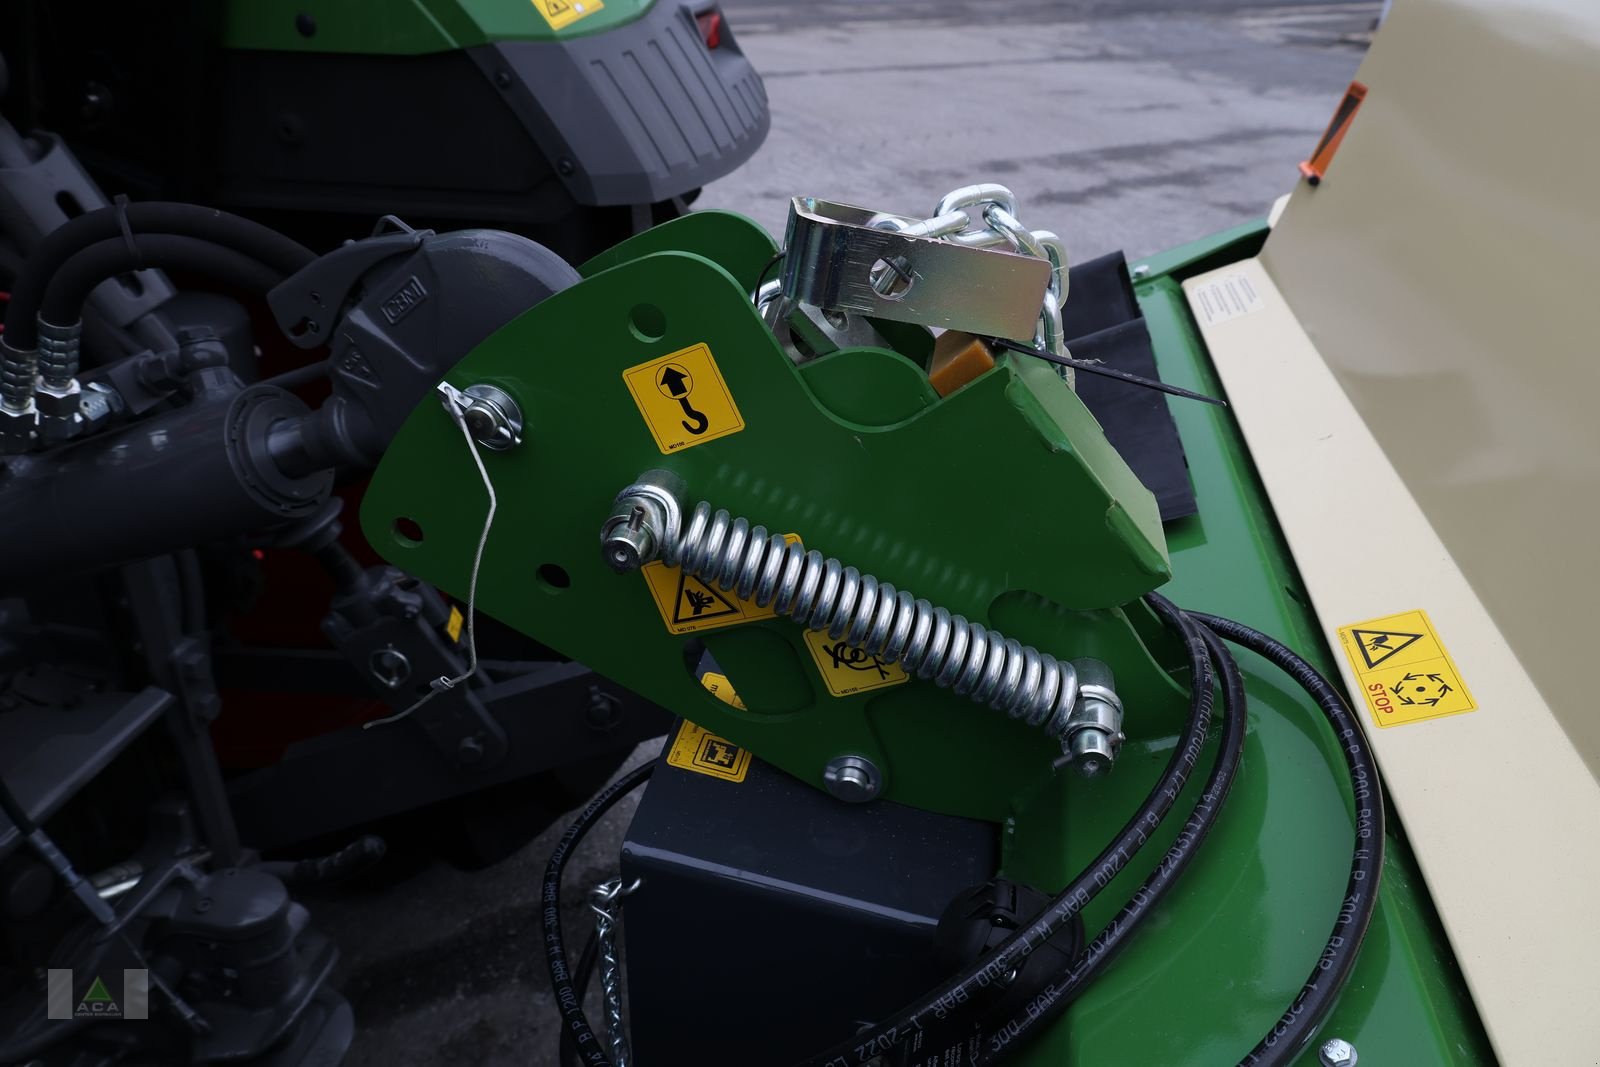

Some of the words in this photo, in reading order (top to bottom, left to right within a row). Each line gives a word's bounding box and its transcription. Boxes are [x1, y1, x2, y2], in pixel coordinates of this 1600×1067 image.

[385, 280, 424, 318] CBM
[1210, 617, 1265, 646] AMAZONE
[1367, 682, 1395, 715] STOP
[1093, 846, 1131, 888] 1200
[543, 906, 559, 929] 300
[1055, 886, 1091, 923] BAR
[551, 959, 569, 984] BAR
[559, 986, 580, 1015] 1200
[934, 986, 970, 1020] BAR
[571, 1019, 588, 1031] P
[990, 1018, 1021, 1053] 300
[1024, 983, 1062, 1020] BAR
[578, 1031, 593, 1045] B
[854, 1014, 923, 1062] 1-2022
